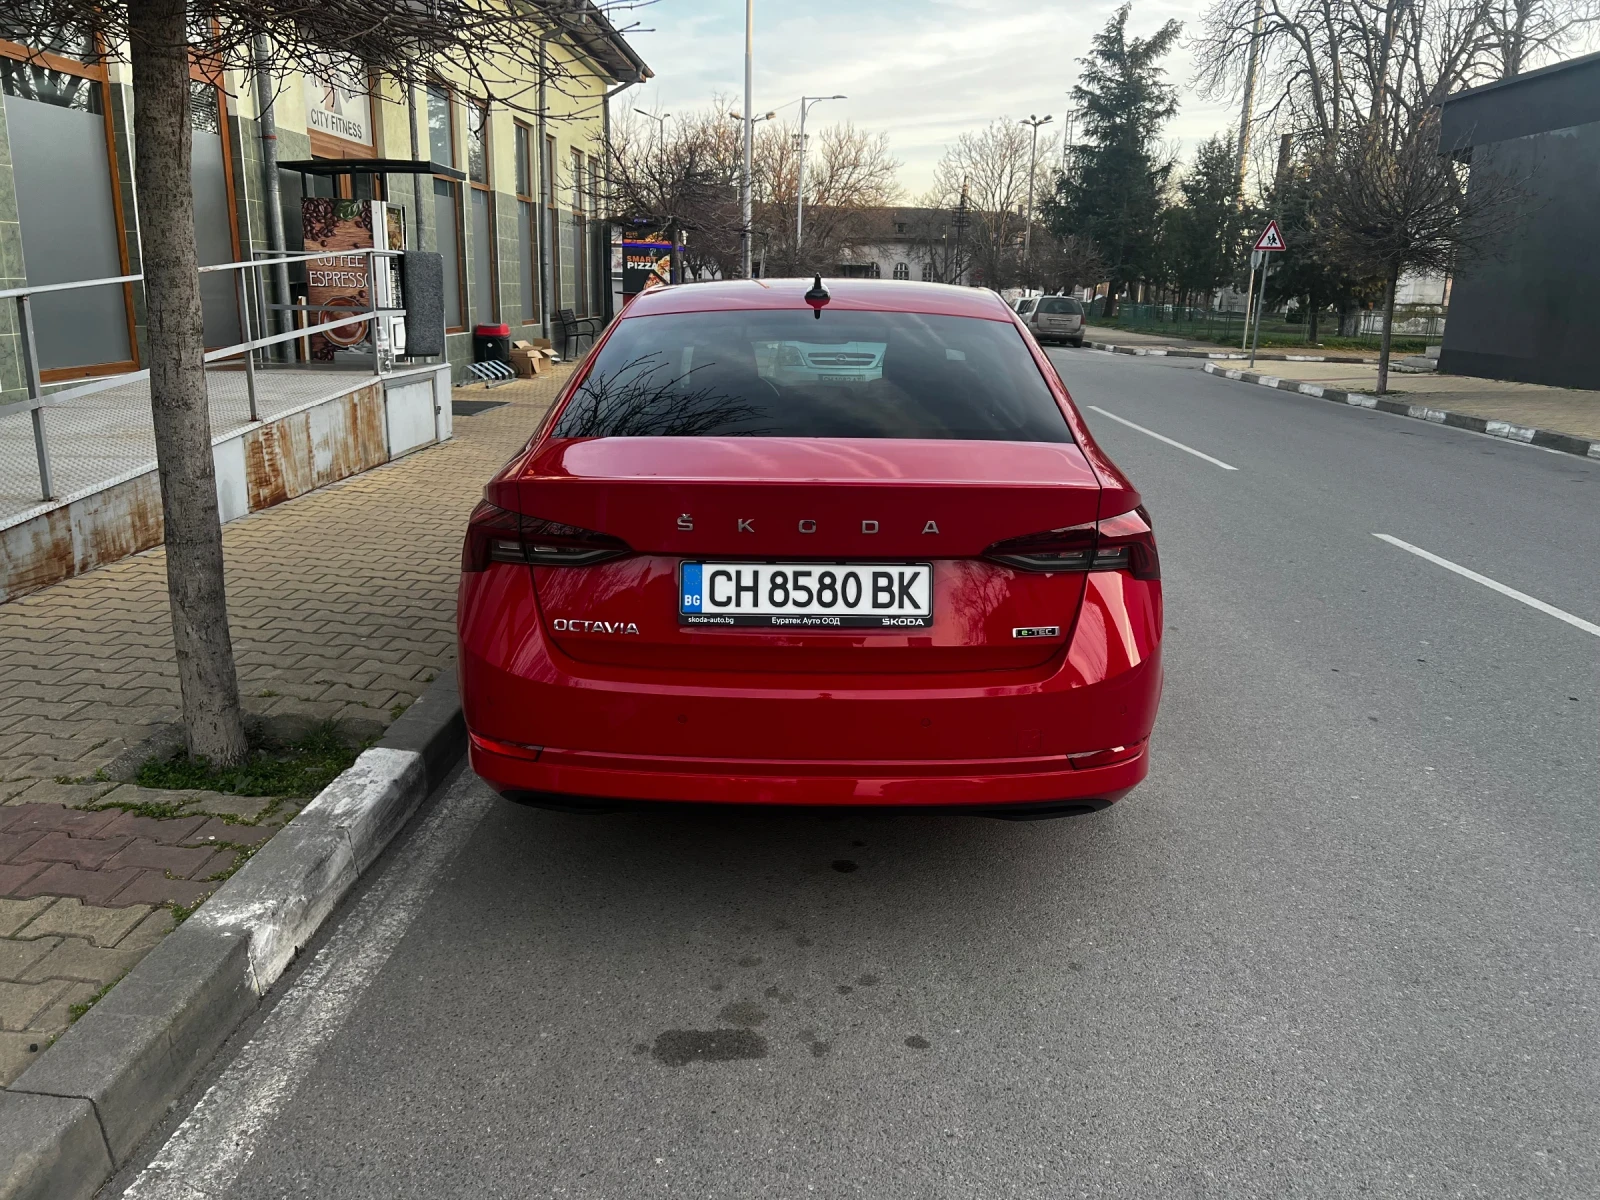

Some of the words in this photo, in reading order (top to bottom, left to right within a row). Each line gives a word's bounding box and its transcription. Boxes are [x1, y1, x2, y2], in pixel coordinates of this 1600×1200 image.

[311, 108, 330, 128] CITY
[330, 115, 362, 140] FITNESS
[626, 255, 658, 263] SMART
[627, 261, 658, 270] PIZZA
[676, 513, 940, 535] ŠKODA
[709, 569, 759, 608] CH
[768, 570, 862, 609] 8580
[872, 571, 922, 610] BK
[684, 594, 701, 606] BG
[553, 618, 640, 635] OCTAVIA
[688, 616, 735, 625] skoda-auto.bg
[821, 617, 841, 626] ООД
